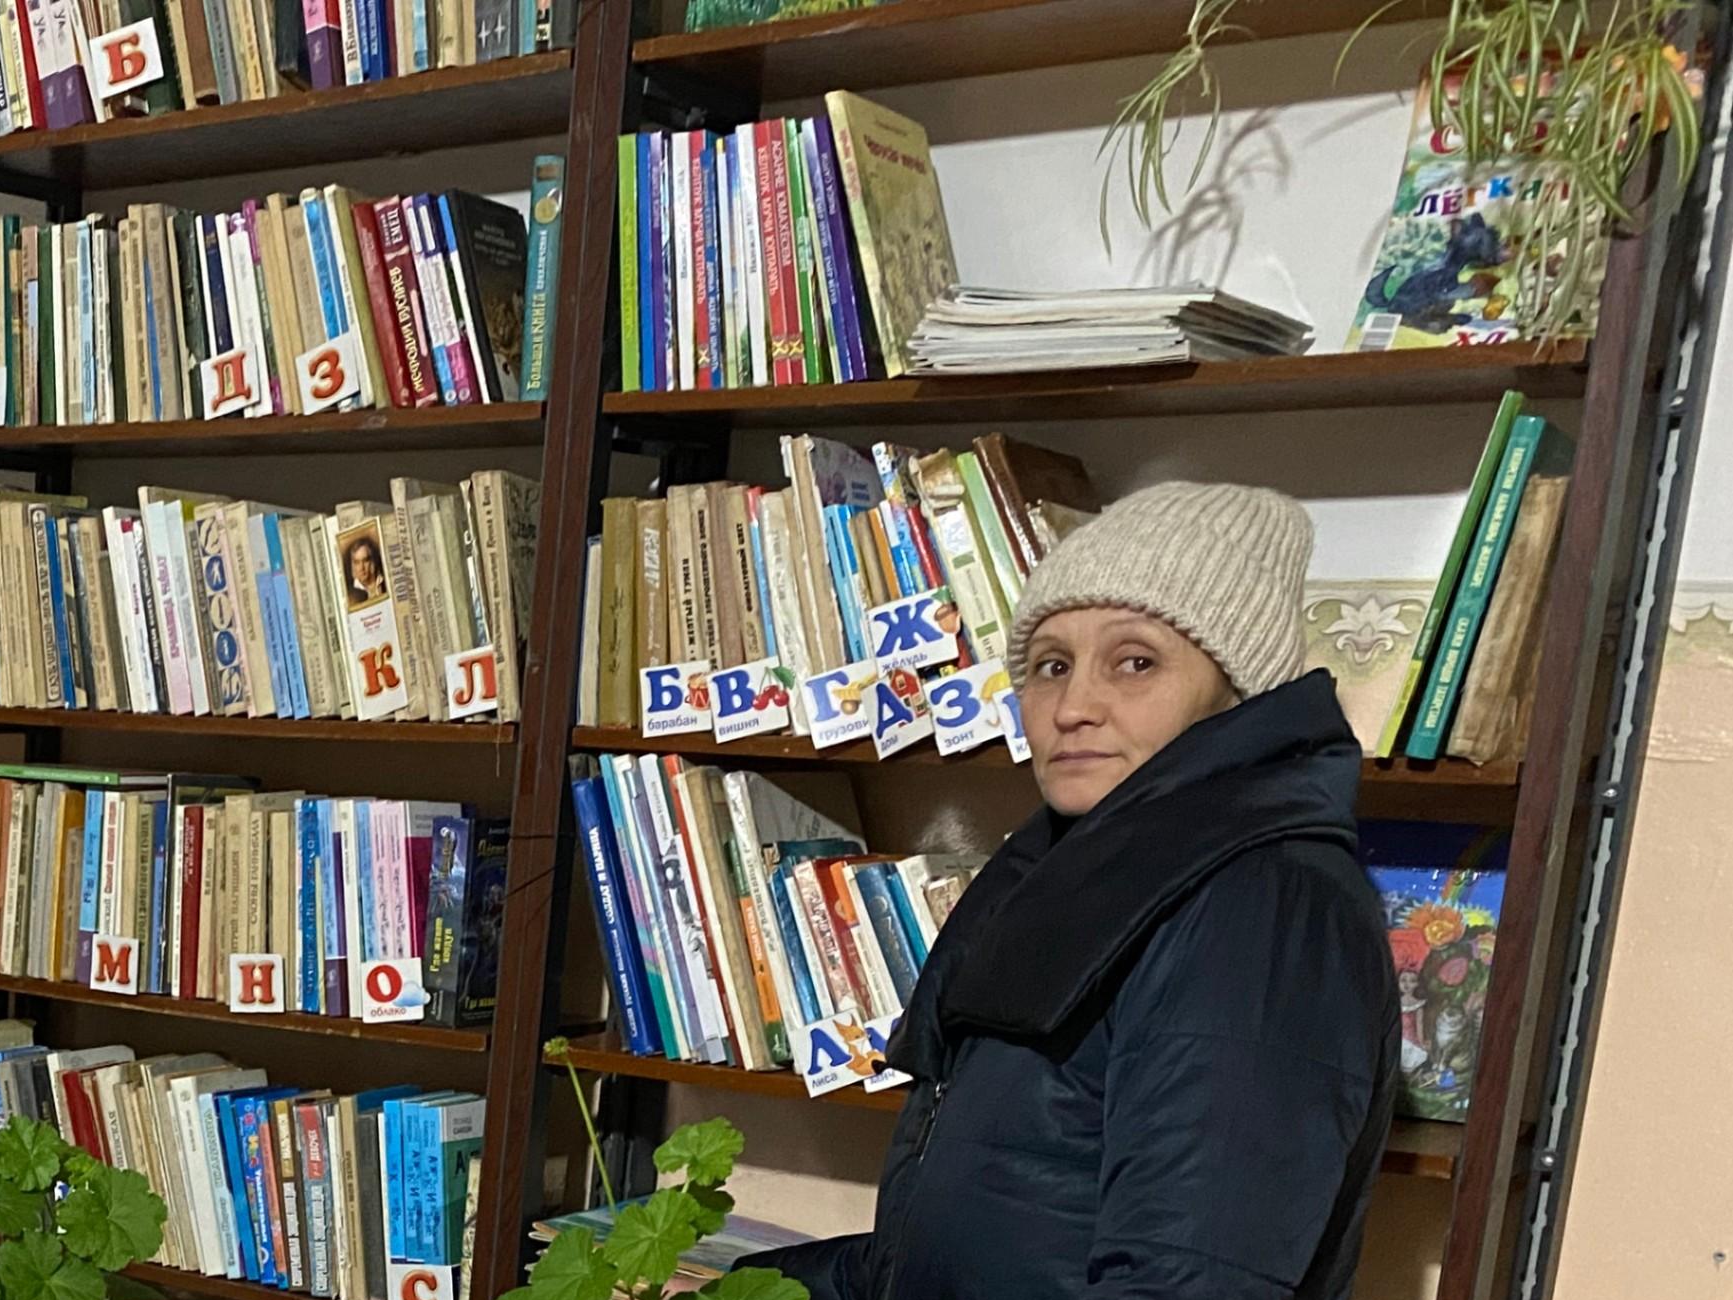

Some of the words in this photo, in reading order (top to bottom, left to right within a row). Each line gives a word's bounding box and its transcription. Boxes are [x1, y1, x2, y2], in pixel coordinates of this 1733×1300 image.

[104, 32, 149, 84] Б
[387, 208, 403, 245] ЕМЕЦ
[211, 352, 253, 413] Д
[307, 348, 345, 400] З
[874, 598, 944, 656] Ж
[356, 642, 401, 699] К
[452, 653, 499, 706] Л
[645, 667, 684, 713] Б
[711, 667, 755, 718] В
[804, 670, 850, 723] Г
[875, 682, 914, 739] Д
[928, 678, 982, 729] З
[647, 714, 699, 731] барабан
[718, 718, 760, 736] вишня
[818, 719, 870, 741] грузови
[944, 730, 976, 748] зонт
[94, 941, 135, 986] М
[237, 961, 277, 1006] Н
[366, 964, 403, 1003] О
[370, 1005, 407, 1018] облако
[807, 1027, 852, 1075] Л
[810, 1070, 839, 1090] лиса
